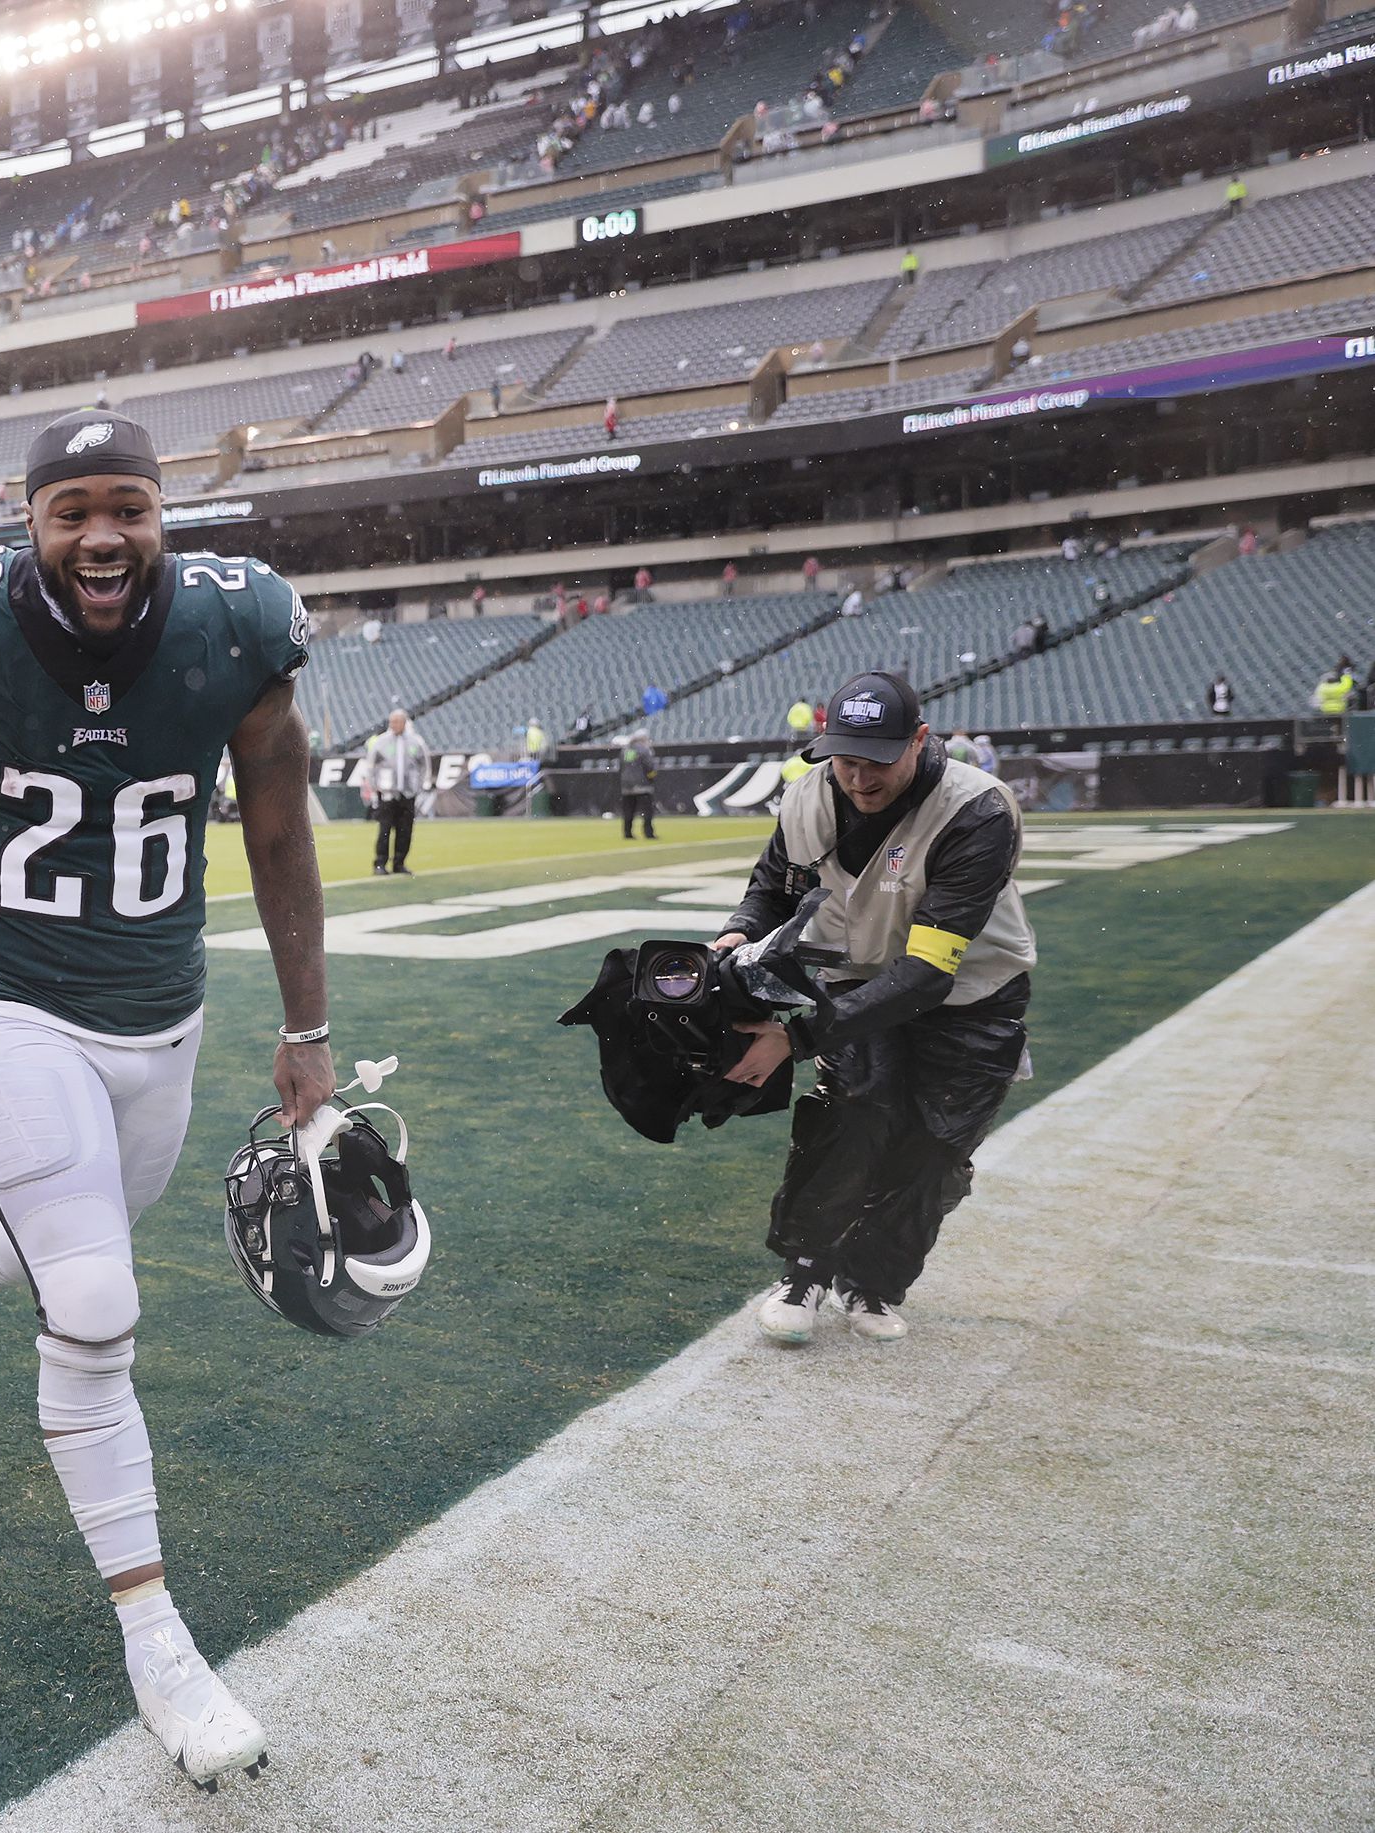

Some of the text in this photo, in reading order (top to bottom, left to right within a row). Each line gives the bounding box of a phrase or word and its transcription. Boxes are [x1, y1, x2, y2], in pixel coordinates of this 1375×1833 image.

[1285, 51, 1345, 80] Lincoln
[1032, 95, 1192, 149] Lincoln Financial Group
[582, 209, 637, 242] 0:00
[229, 249, 429, 308] Lincoln Financial Field
[918, 389, 1089, 430] Lincoln Financial Group
[493, 454, 642, 485] Lincoln Financial Group
[89, 696, 107, 708] NFL
[72, 728, 128, 747] EAGLES
